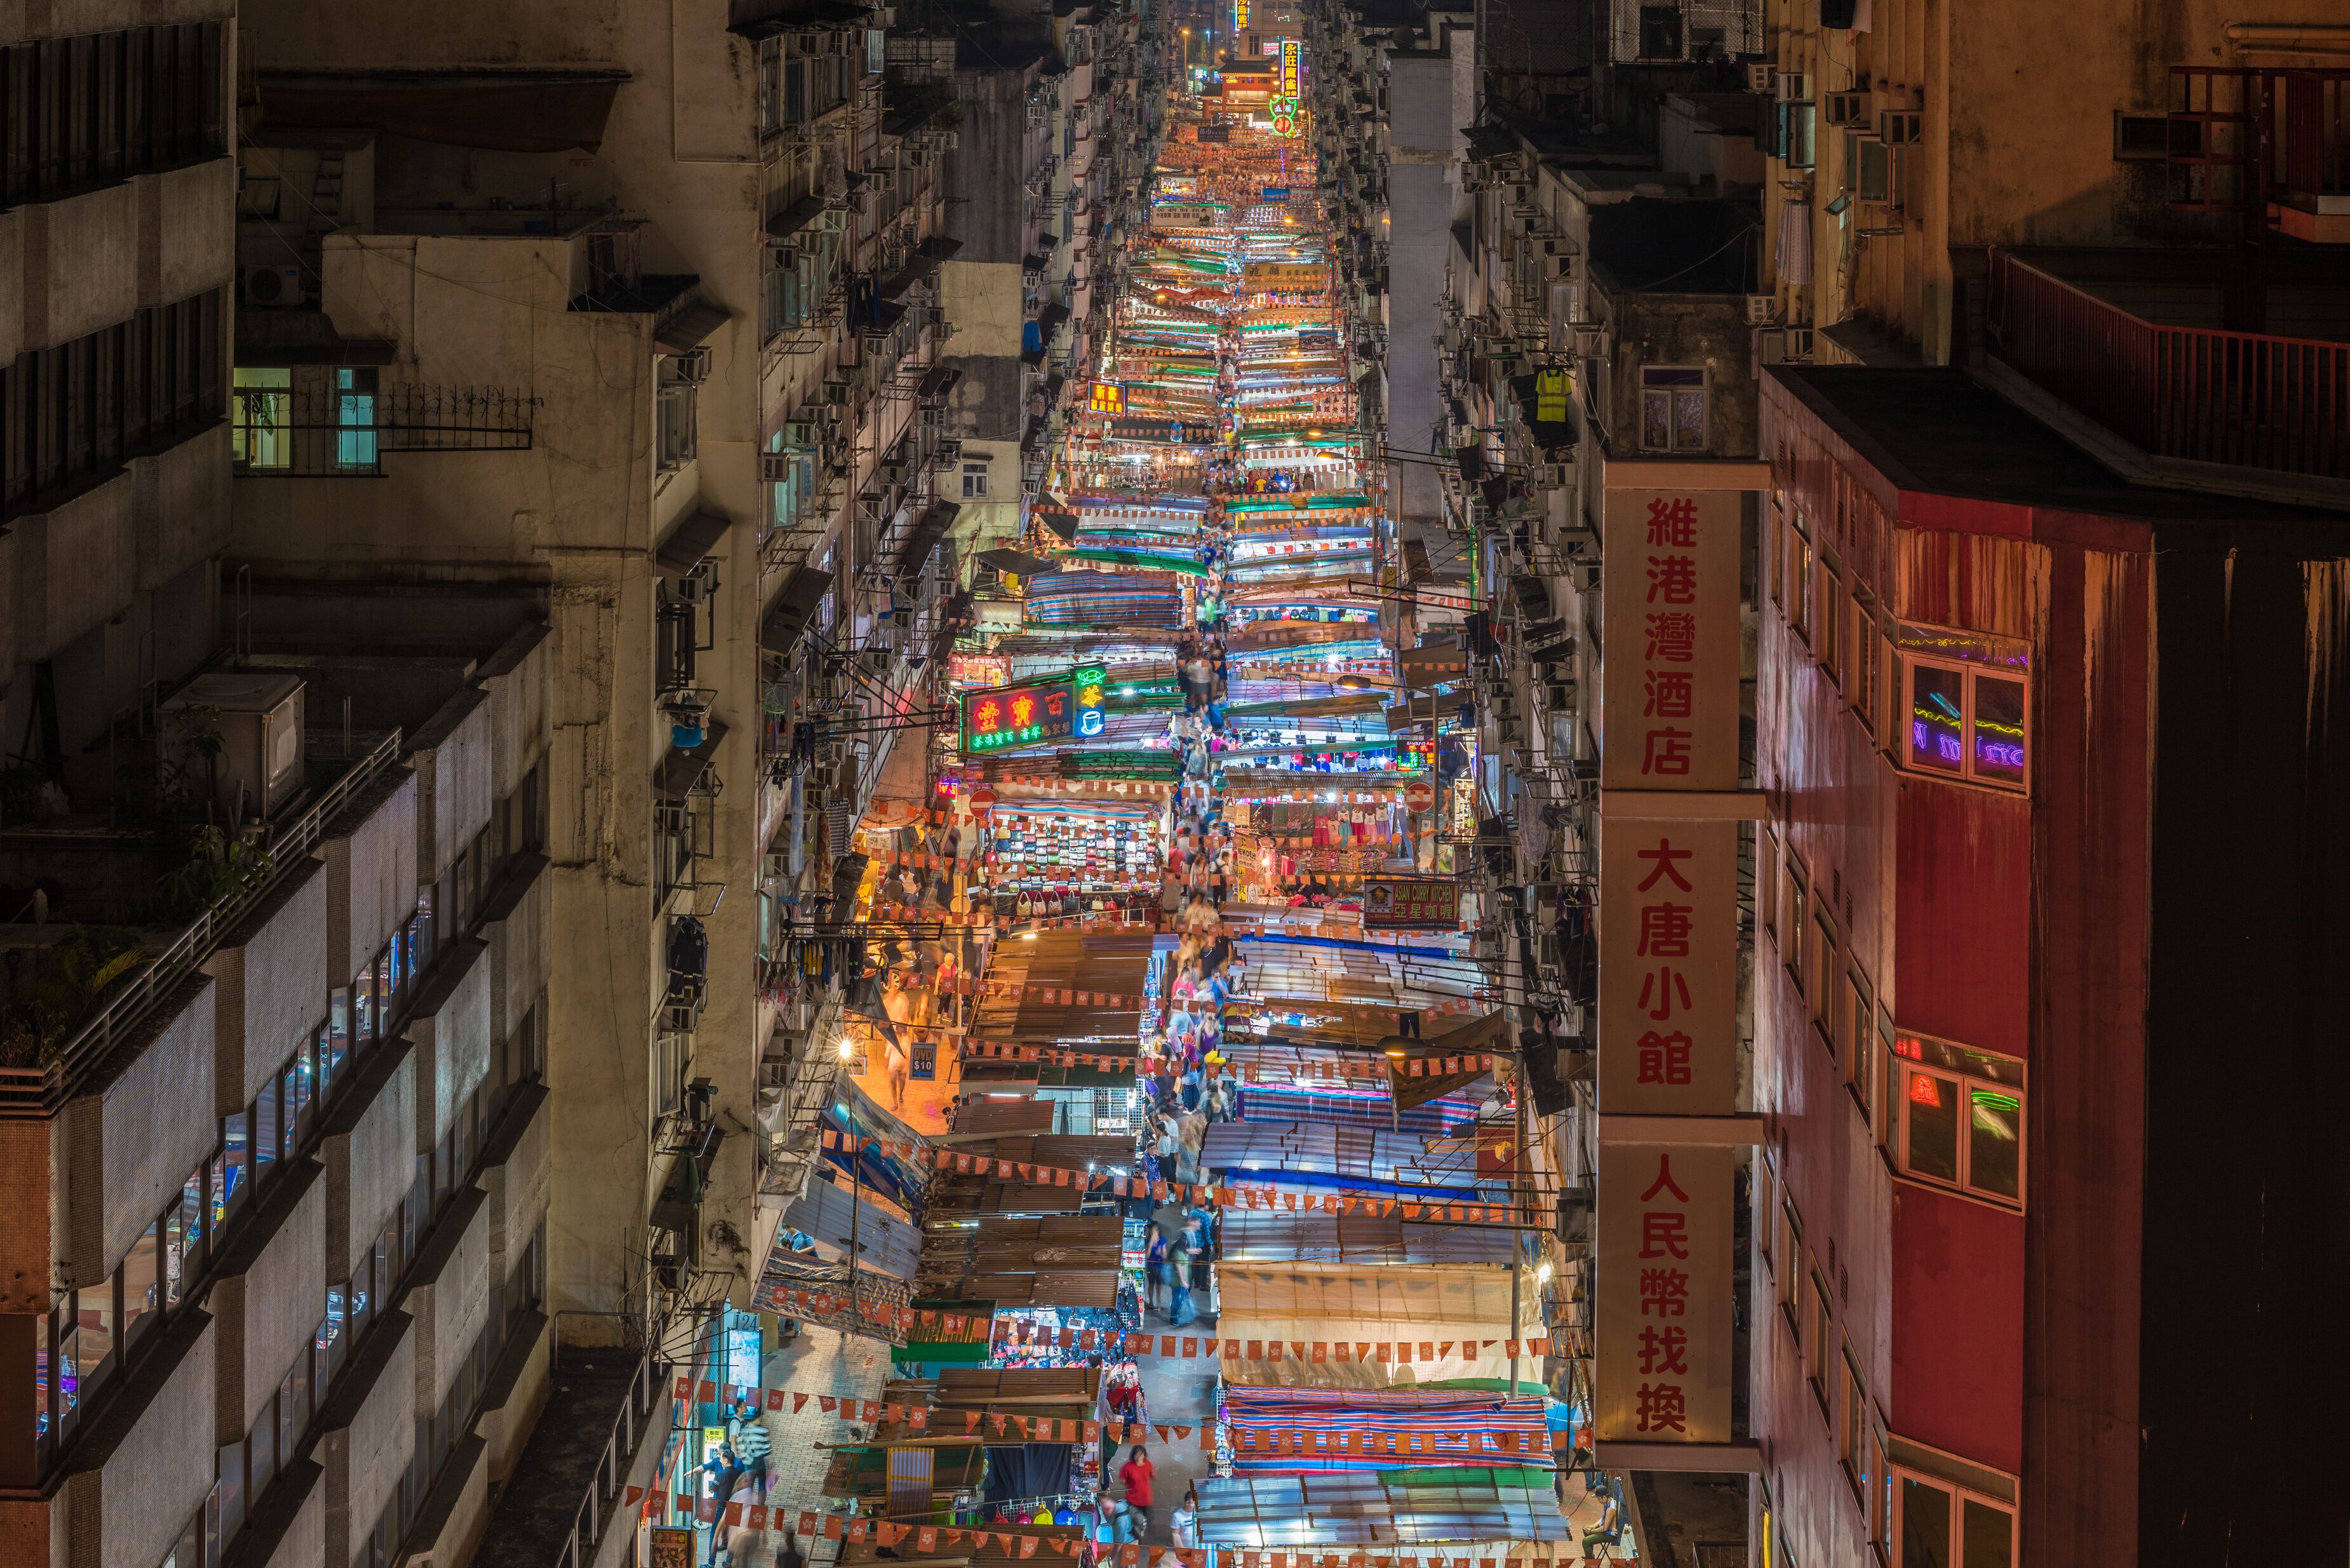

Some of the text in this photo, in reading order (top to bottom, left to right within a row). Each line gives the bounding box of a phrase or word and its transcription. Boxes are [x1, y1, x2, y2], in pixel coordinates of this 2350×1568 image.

[1285, 44, 1297, 90] 永旺麻雀
[1641, 497, 1698, 775] 維港灣酒店
[1395, 884, 1453, 902] ASIAN CURRY KITCHEN
[1393, 904, 1453, 920] 亞星咖喱
[1637, 838, 1693, 1085] 大唐小館
[914, 1049, 933, 1061] DVD
[914, 1060, 932, 1071] $10
[1636, 1153, 1689, 1433] 人民幣找換
[735, 1314, 758, 1332] 124
